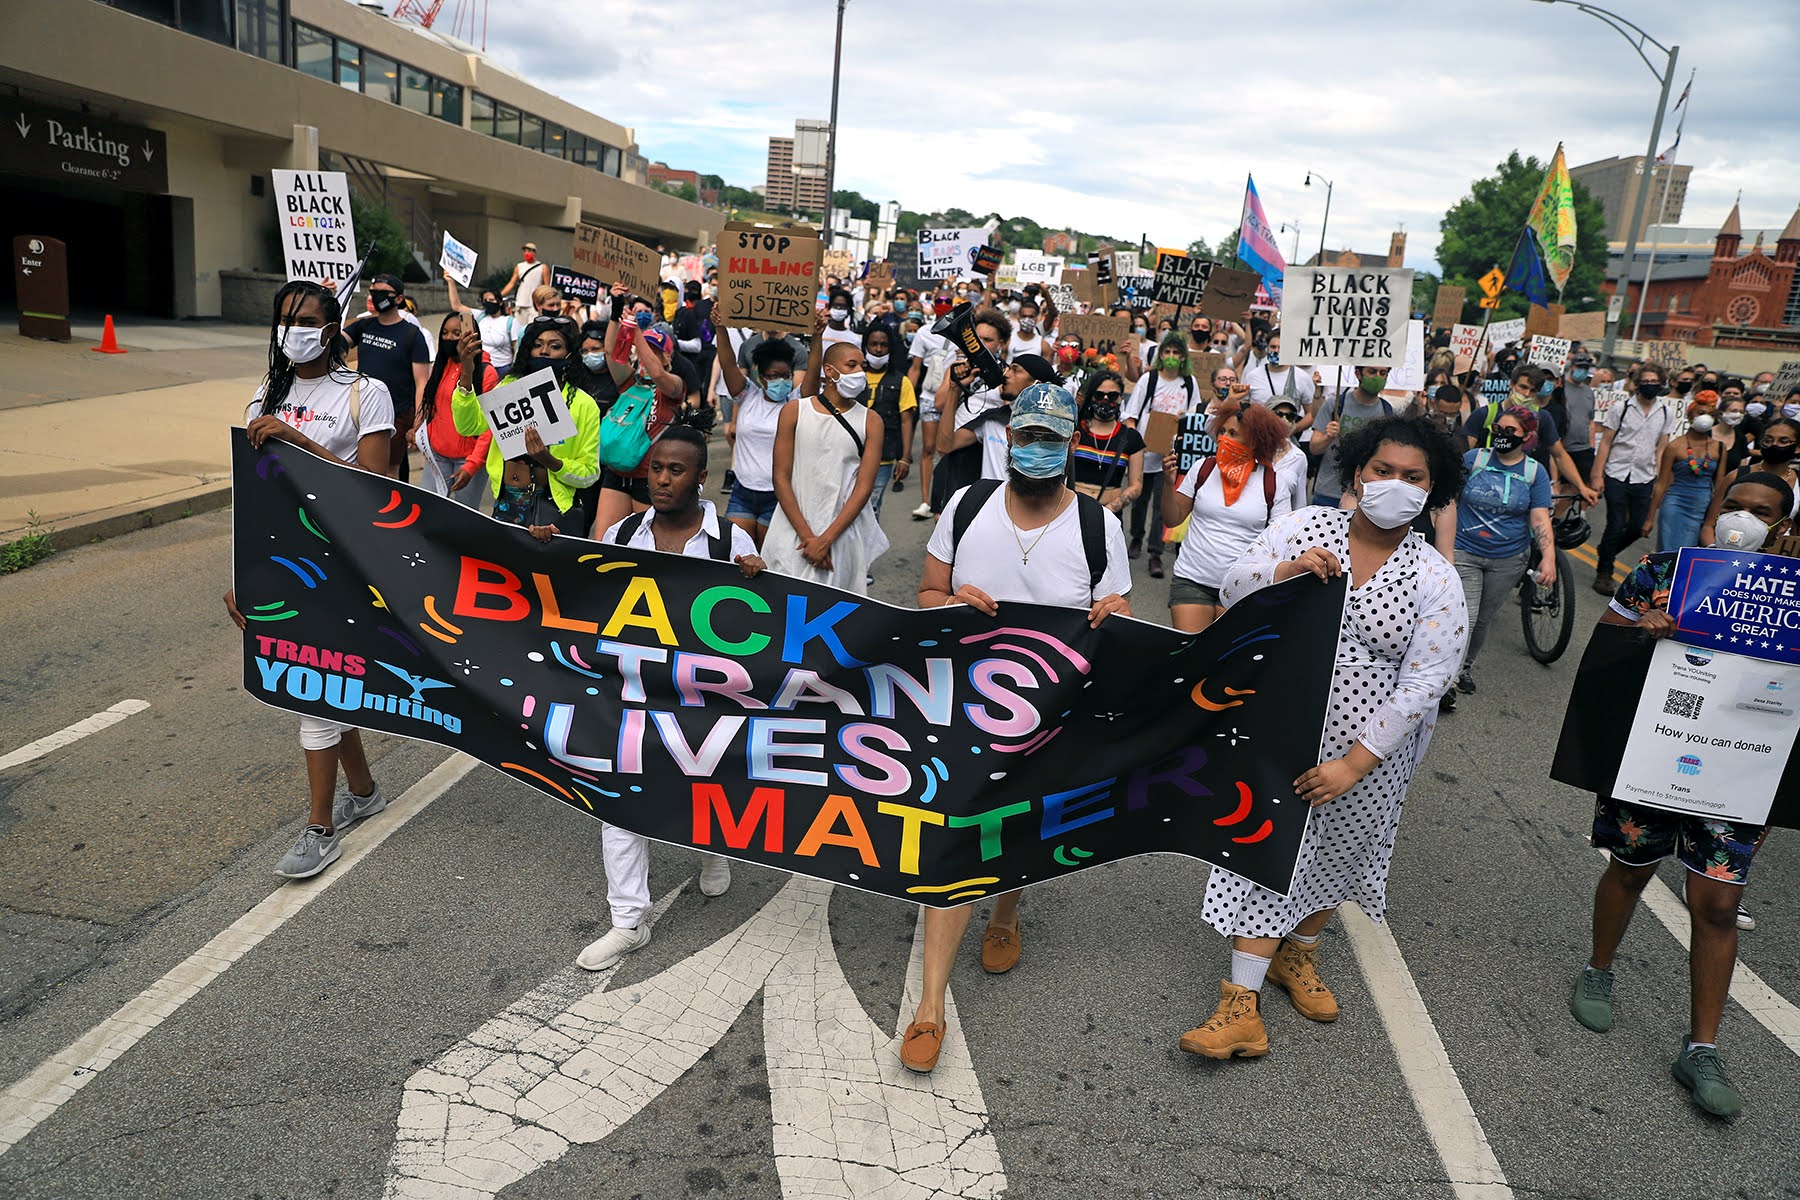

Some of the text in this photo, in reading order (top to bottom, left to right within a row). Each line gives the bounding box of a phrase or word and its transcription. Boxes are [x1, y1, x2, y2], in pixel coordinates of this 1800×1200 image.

[47, 119, 130, 167] Parking
[61, 161, 100, 178] Clearance
[294, 174, 328, 192] ALL
[286, 195, 344, 214] BLACK
[289, 216, 345, 229] LGBTQIA+
[294, 233, 347, 253] LIVES
[578, 226, 601, 244] IF
[602, 232, 622, 252] ALL
[738, 232, 791, 254] STOP
[919, 230, 960, 244] BLACK
[920, 241, 961, 258] TRANS
[920, 251, 953, 266] LIVES
[22, 257, 42, 267] Enter
[291, 259, 354, 280] MATTER
[728, 256, 815, 277] KILLING
[1021, 262, 1061, 277] LGBT
[554, 273, 598, 290] TRANS
[619, 270, 637, 289] YOU
[920, 266, 964, 279] MATTER
[1156, 272, 1187, 286] TRANS
[564, 286, 596, 298] & PROUD
[729, 279, 809, 296] OUR TRANS
[1311, 274, 1390, 294] BLACK
[731, 292, 811, 317] SISTERS
[1156, 284, 1204, 306] MATTE
[1312, 296, 1391, 316] TRANS
[1308, 317, 1387, 338] LIVES
[1463, 327, 1478, 337] NO
[375, 336, 397, 347] AMERICA
[1299, 338, 1392, 358] MATTER
[1536, 336, 1568, 348] BLACK
[1537, 345, 1566, 356] TRANS
[1460, 347, 1473, 356] NO
[1531, 352, 1559, 364] LIVES
[489, 380, 559, 431] LGBT
[1037, 390, 1053, 410] LA
[499, 426, 524, 441] stands
[1734, 573, 1797, 597] HATE
[1722, 588, 1750, 600] DOES
[1751, 593, 1773, 603] NOT
[452, 555, 871, 670] BLACK
[1694, 595, 1800, 630] AMERIC
[1731, 622, 1779, 639] GREAT
[255, 634, 367, 676] TRANS
[1672, 662, 1687, 672] Trans
[254, 655, 463, 735] YOUniting
[595, 637, 1042, 738] TRANS
[1691, 695, 1705, 720] venmo
[1654, 723, 1772, 754] How you can donate
[542, 701, 913, 797] LIVES
[1625, 784, 1655, 797] Payment
[1670, 784, 1691, 794] Trans
[690, 746, 1215, 876] MATTER
